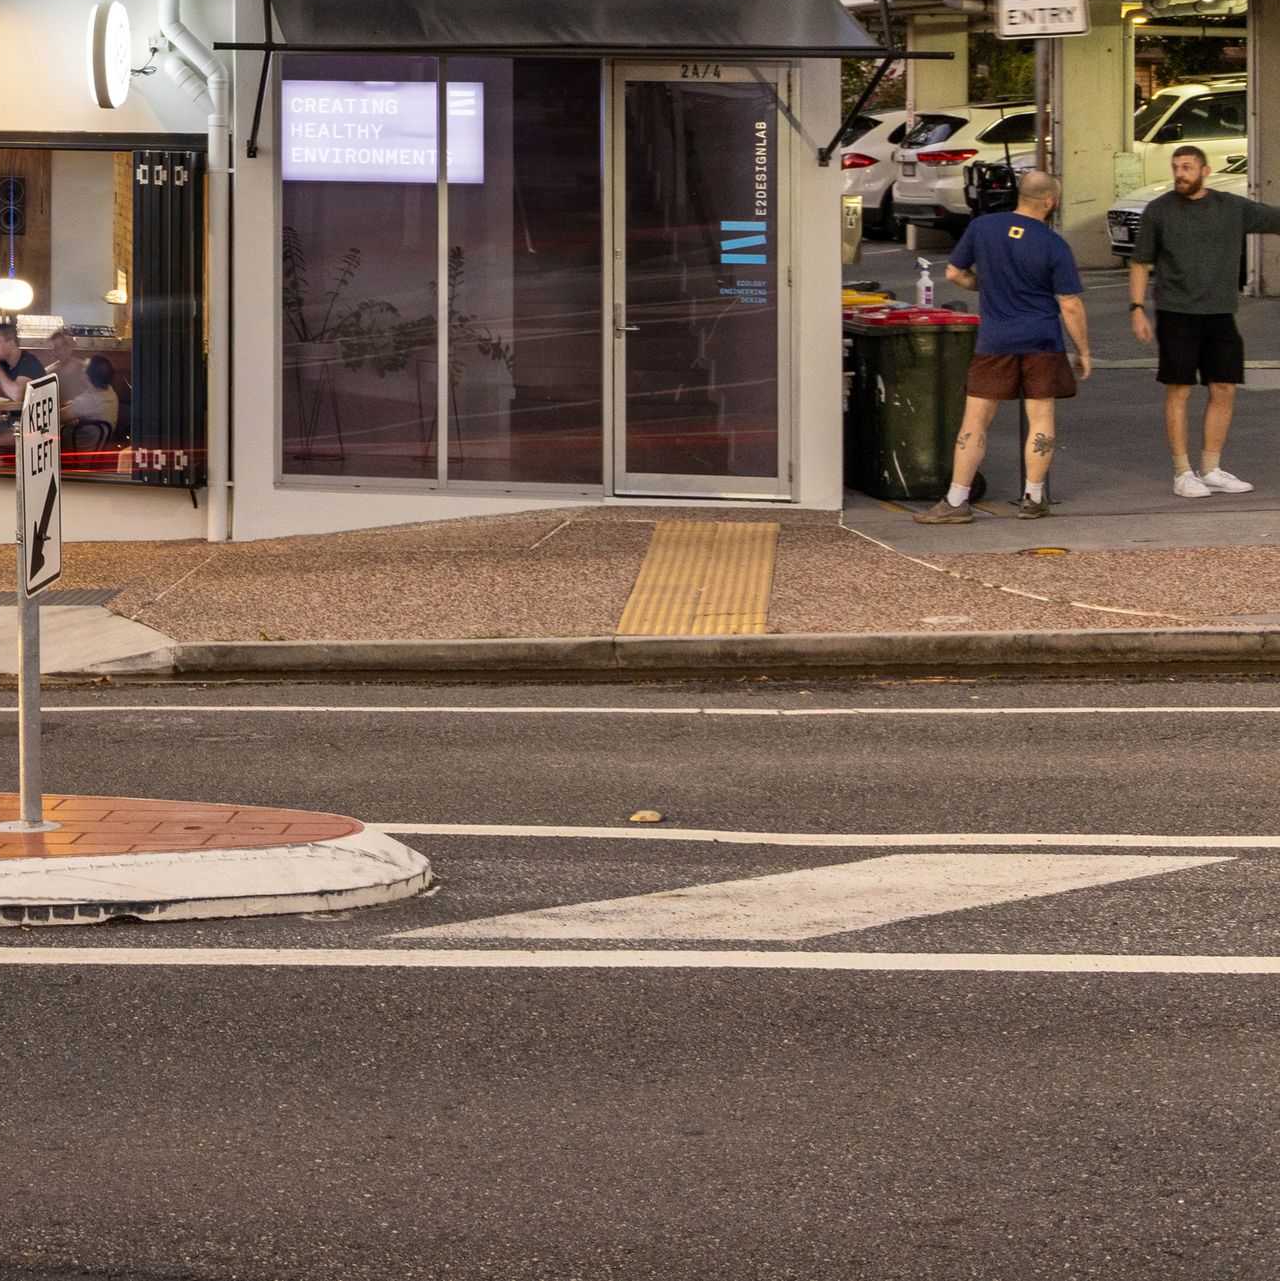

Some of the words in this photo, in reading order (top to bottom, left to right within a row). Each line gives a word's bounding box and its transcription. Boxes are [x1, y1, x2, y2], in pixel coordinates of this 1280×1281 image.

[1007, 6, 1078, 25] ENTRY
[290, 97, 398, 114] CREATING
[290, 122, 383, 139] HEALTHY
[755, 121, 767, 216] E2DESIGNLAB
[28, 396, 54, 434] KEEP
[30, 438, 54, 476] LEFT
